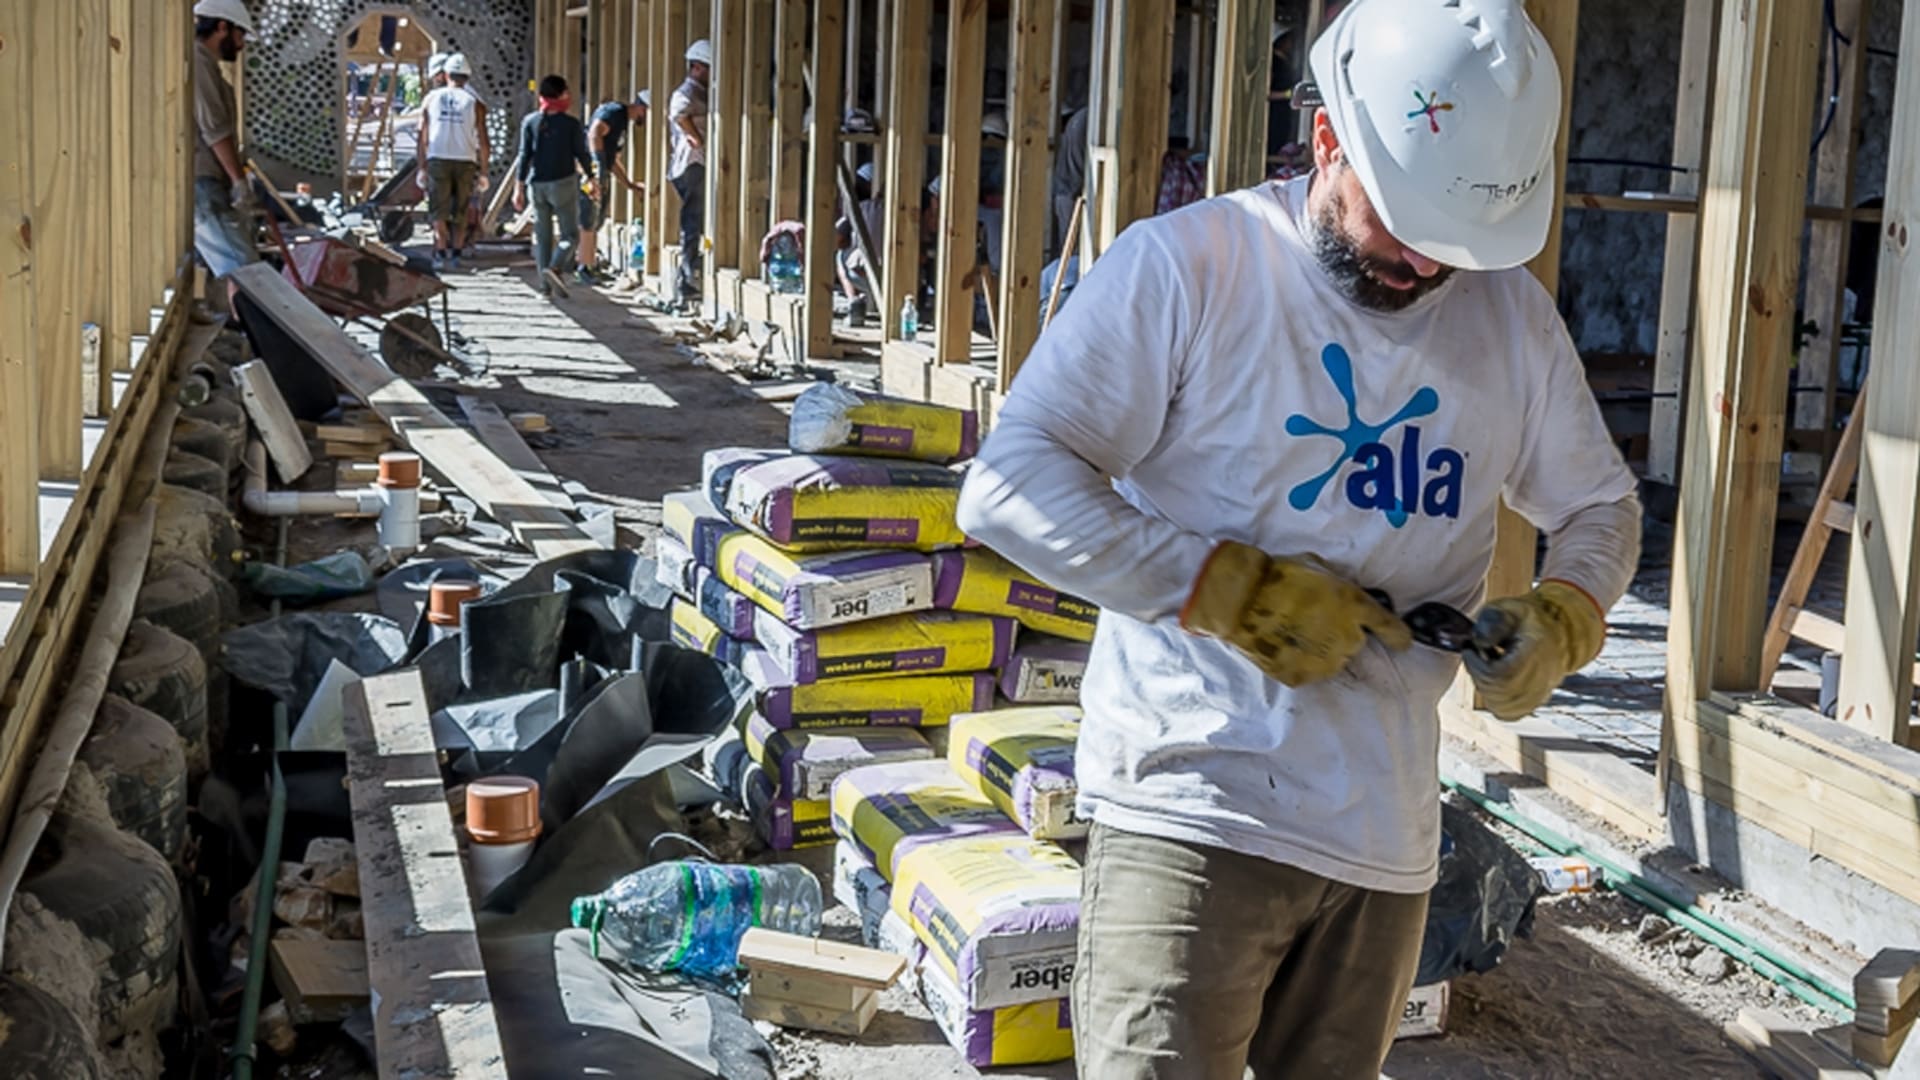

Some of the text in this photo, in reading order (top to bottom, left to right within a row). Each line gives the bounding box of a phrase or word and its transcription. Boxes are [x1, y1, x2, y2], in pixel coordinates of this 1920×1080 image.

[1346, 424, 1465, 520] ala
[831, 599, 868, 618] ber
[824, 661, 861, 674] weber
[863, 657, 893, 670] floor
[1010, 964, 1075, 990] eber
